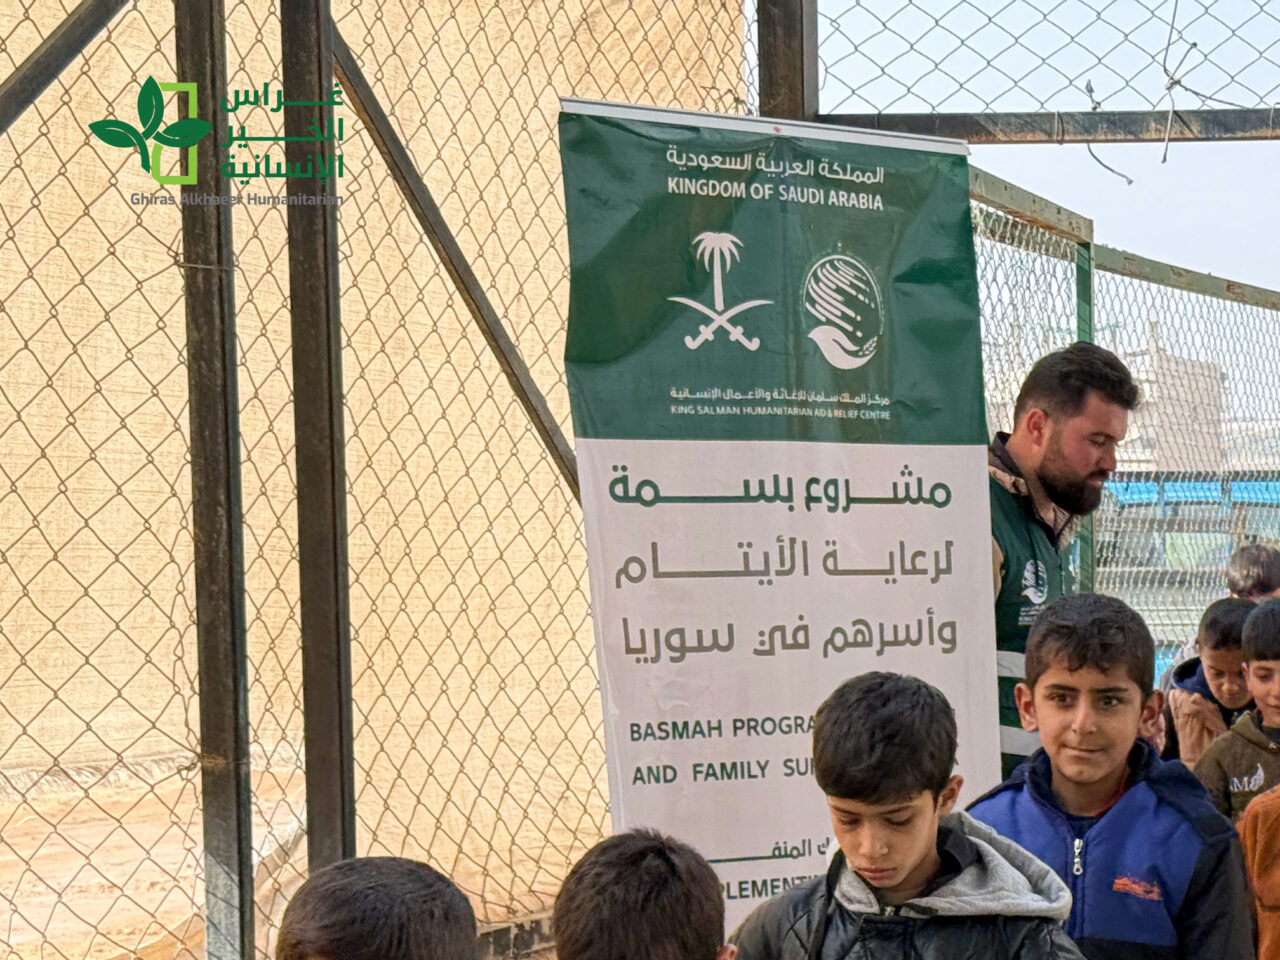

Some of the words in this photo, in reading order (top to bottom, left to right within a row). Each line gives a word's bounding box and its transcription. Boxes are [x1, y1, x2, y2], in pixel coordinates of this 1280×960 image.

[667, 144, 751, 171] السعودية
[756, 152, 814, 178] العربية
[819, 158, 884, 184] المملكة
[668, 177, 746, 198] KINGDOM
[750, 183, 774, 199] OF
[779, 185, 824, 205] SAUDI
[829, 190, 884, 211] ARABIA
[671, 405, 695, 415] KING
[697, 406, 741, 415] SALMAN
[743, 406, 813, 417] HUMANITARIAN
[814, 407, 826, 417] AID
[834, 409, 858, 419] RELIEF
[860, 410, 890, 420] CENTRE
[609, 464, 795, 512] بسمة
[805, 464, 952, 512] مشروع
[615, 535, 809, 588] الأيتام
[823, 539, 954, 585] لرعاية
[622, 617, 734, 663] سوريا
[752, 614, 810, 657] في
[823, 608, 957, 658] وأسرهم
[630, 718, 722, 742] BASMAH
[732, 715, 815, 738] PROGRA
[632, 765, 677, 786] AND
[693, 760, 769, 783] FAMILY
[783, 758, 815, 778] SU
